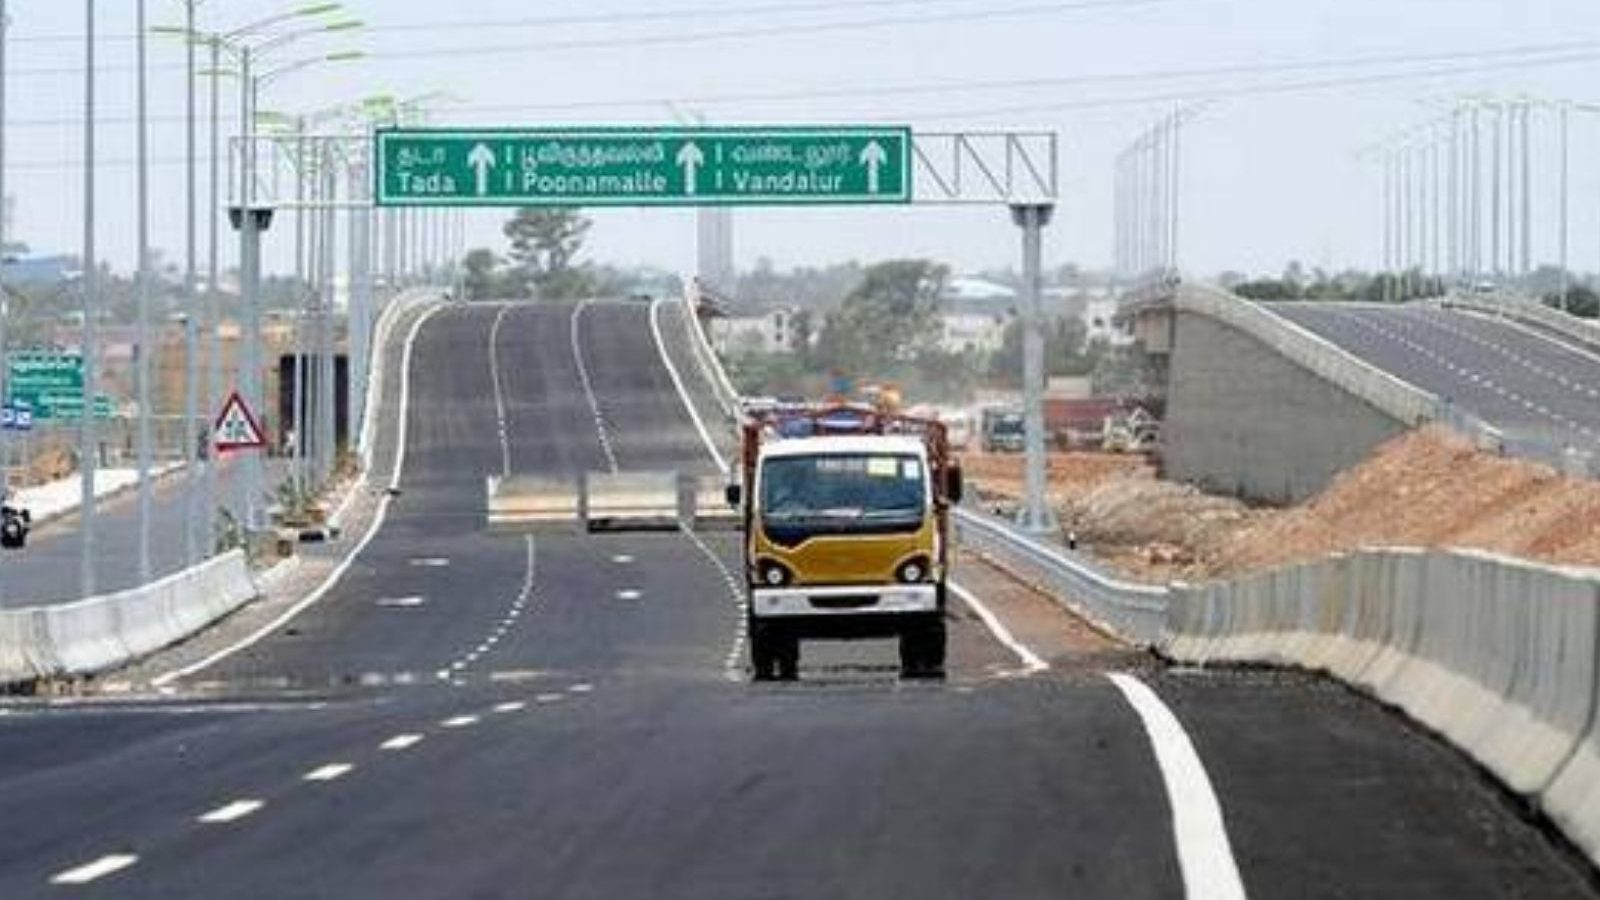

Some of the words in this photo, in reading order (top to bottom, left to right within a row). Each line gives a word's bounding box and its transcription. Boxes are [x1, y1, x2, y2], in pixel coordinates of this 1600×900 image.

[397, 170, 456, 192] Tada
[522, 170, 667, 192] Poonamalle
[734, 171, 842, 191] Vandalur
